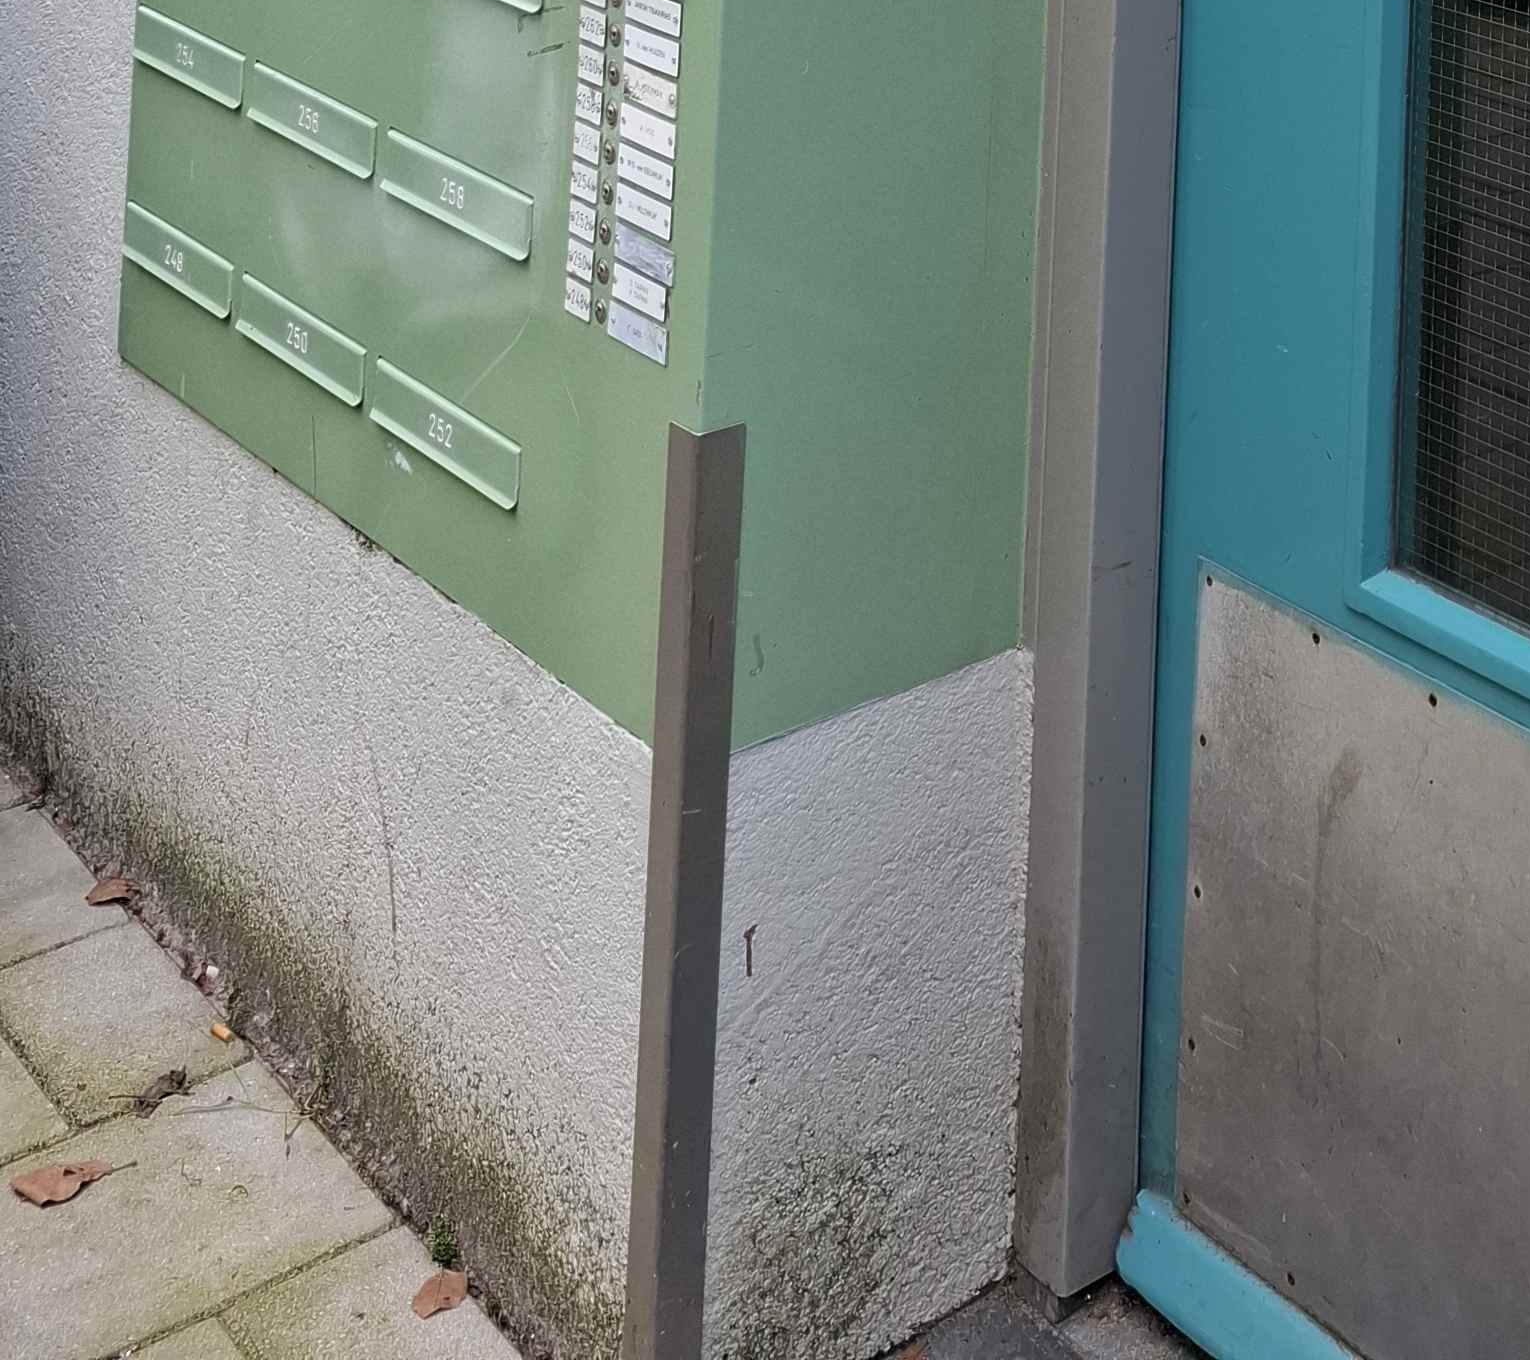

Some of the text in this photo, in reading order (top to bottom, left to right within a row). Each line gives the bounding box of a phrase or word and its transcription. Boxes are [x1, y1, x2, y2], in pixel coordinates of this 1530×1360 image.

[175, 42, 195, 68] 254
[298, 104, 320, 134] 256
[440, 177, 465, 210] 258
[163, 244, 184, 273] 248
[287, 322, 308, 354] 250
[429, 413, 454, 449] 252
